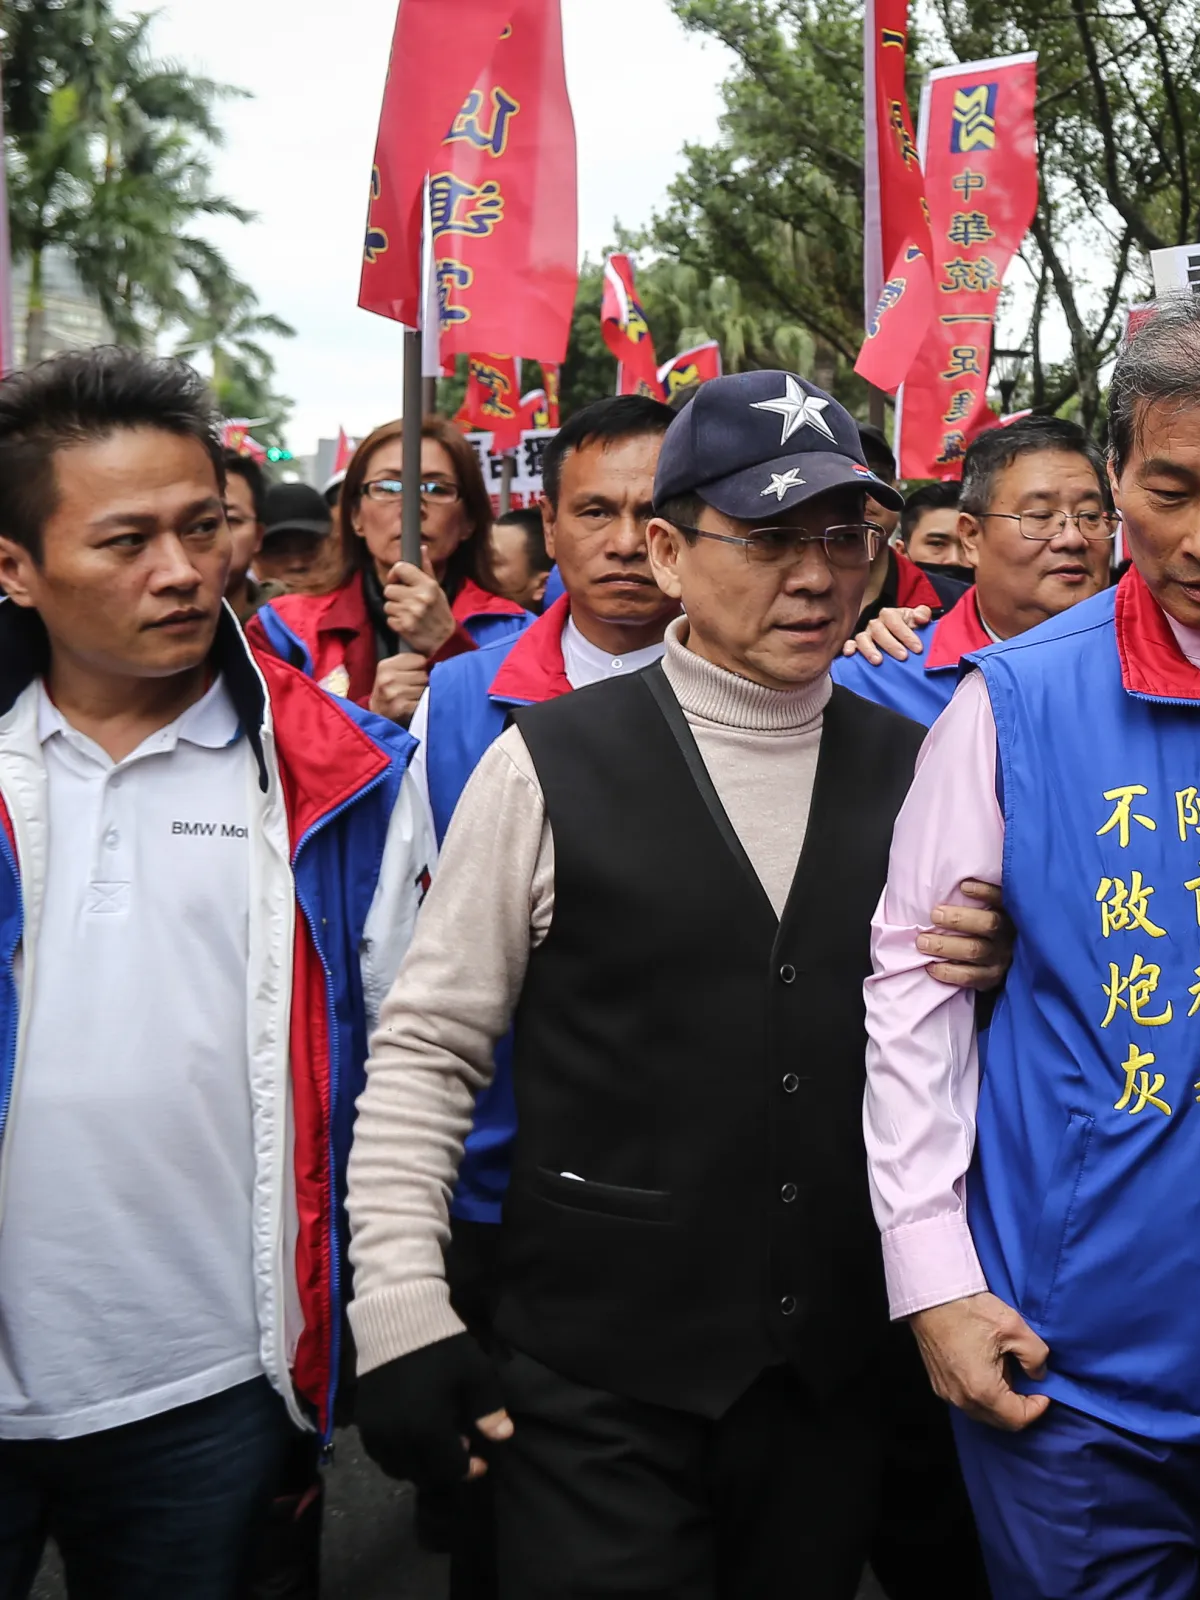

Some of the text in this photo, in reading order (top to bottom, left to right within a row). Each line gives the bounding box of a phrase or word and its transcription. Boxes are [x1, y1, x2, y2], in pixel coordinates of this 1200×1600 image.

[171, 821, 217, 836] BMW
[1095, 783, 1174, 1117] 不做炮灰
